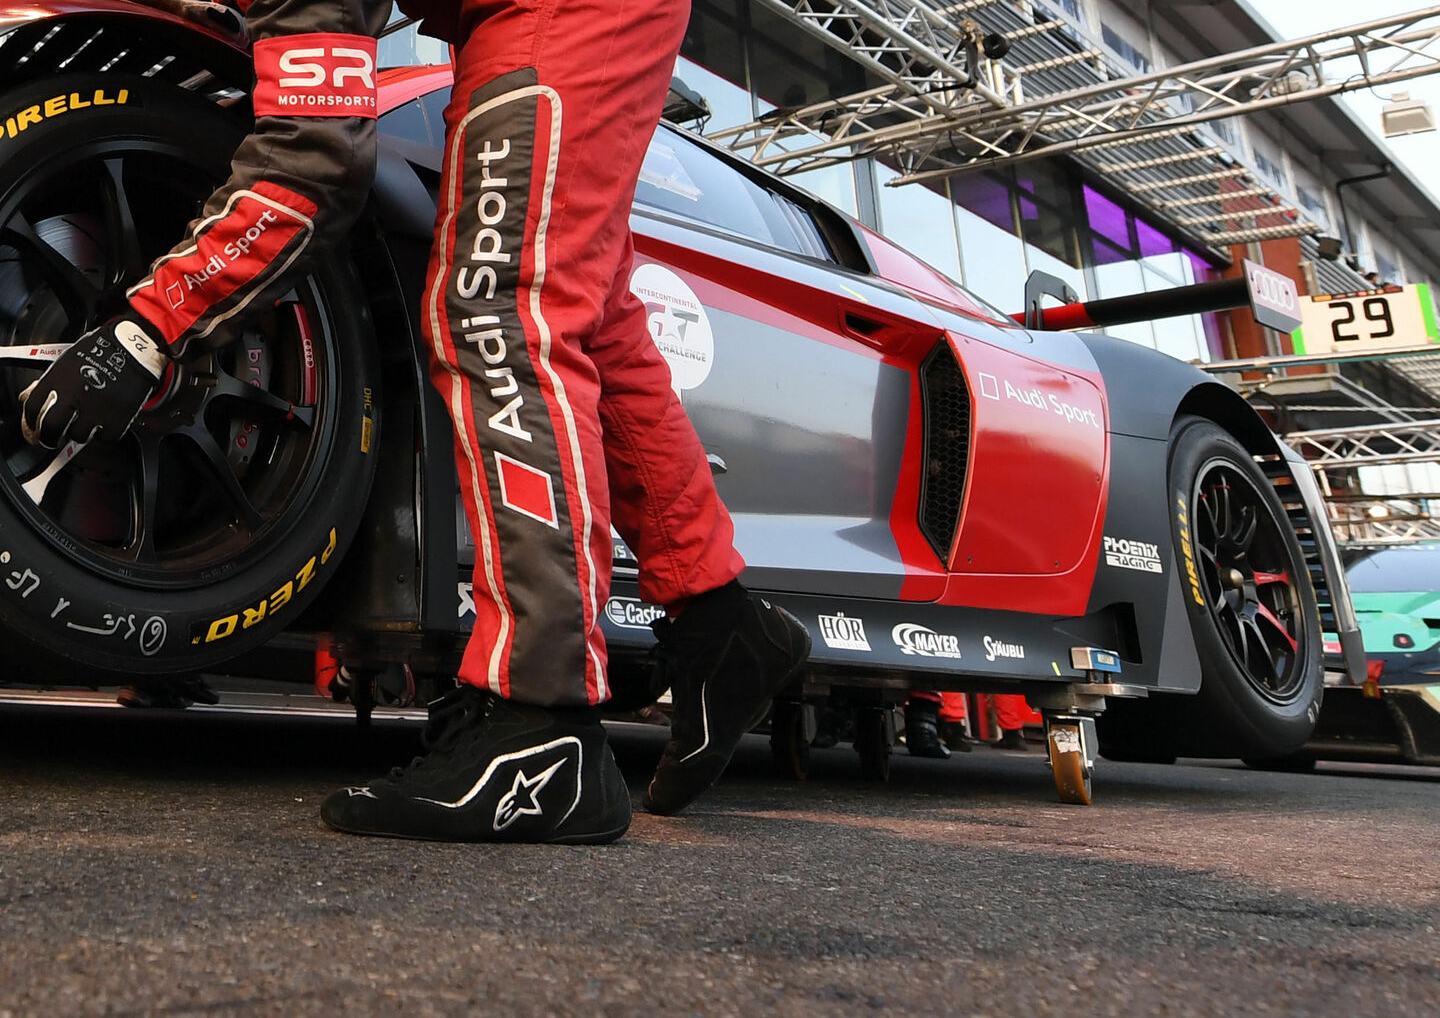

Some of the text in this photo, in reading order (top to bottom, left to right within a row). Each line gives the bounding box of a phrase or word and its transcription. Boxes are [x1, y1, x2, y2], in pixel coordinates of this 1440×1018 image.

[279, 47, 375, 89] SR
[278, 95, 376, 108] MOTORSPORTS
[184, 209, 278, 291] Audi Sport
[456, 138, 534, 442] Audi Sport
[635, 286, 698, 310] INTERCONTINENTAL
[1328, 297, 1394, 342] 29
[1004, 379, 1100, 429] Audi Sport
[1177, 498, 1206, 607] PIRELLI
[821, 612, 866, 642] HÖR
[914, 633, 961, 654] MAYER
